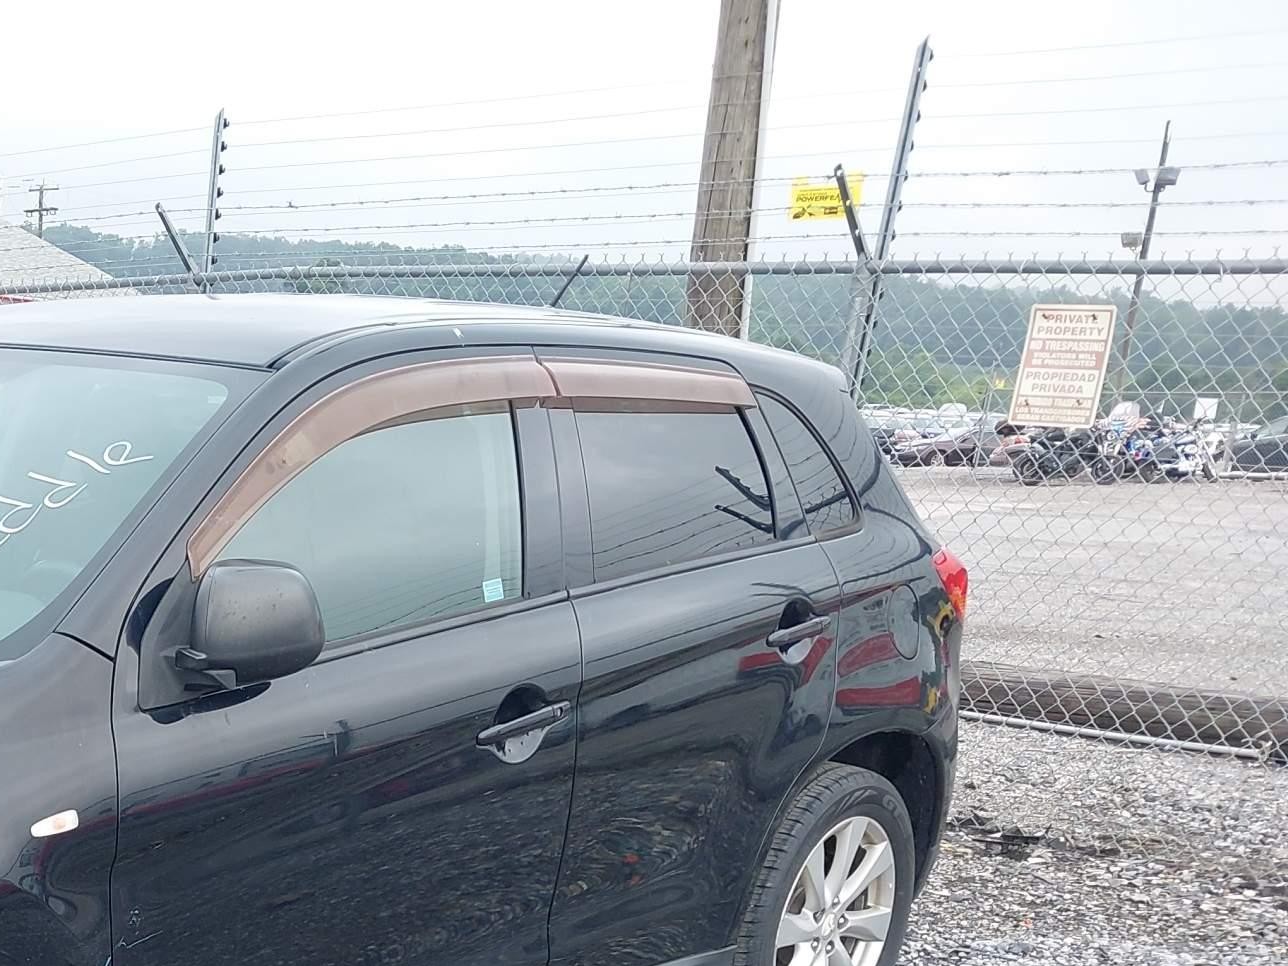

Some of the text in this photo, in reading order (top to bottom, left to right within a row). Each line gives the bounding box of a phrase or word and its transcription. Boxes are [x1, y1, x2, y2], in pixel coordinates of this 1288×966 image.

[1046, 313, 1099, 325] PRIVATE
[1036, 325, 1105, 337] PROPERTY
[1044, 341, 1106, 353] TRESPASSING
[1025, 371, 1097, 383] PROPIEDAD
[1031, 383, 1084, 394] PRIVADA
